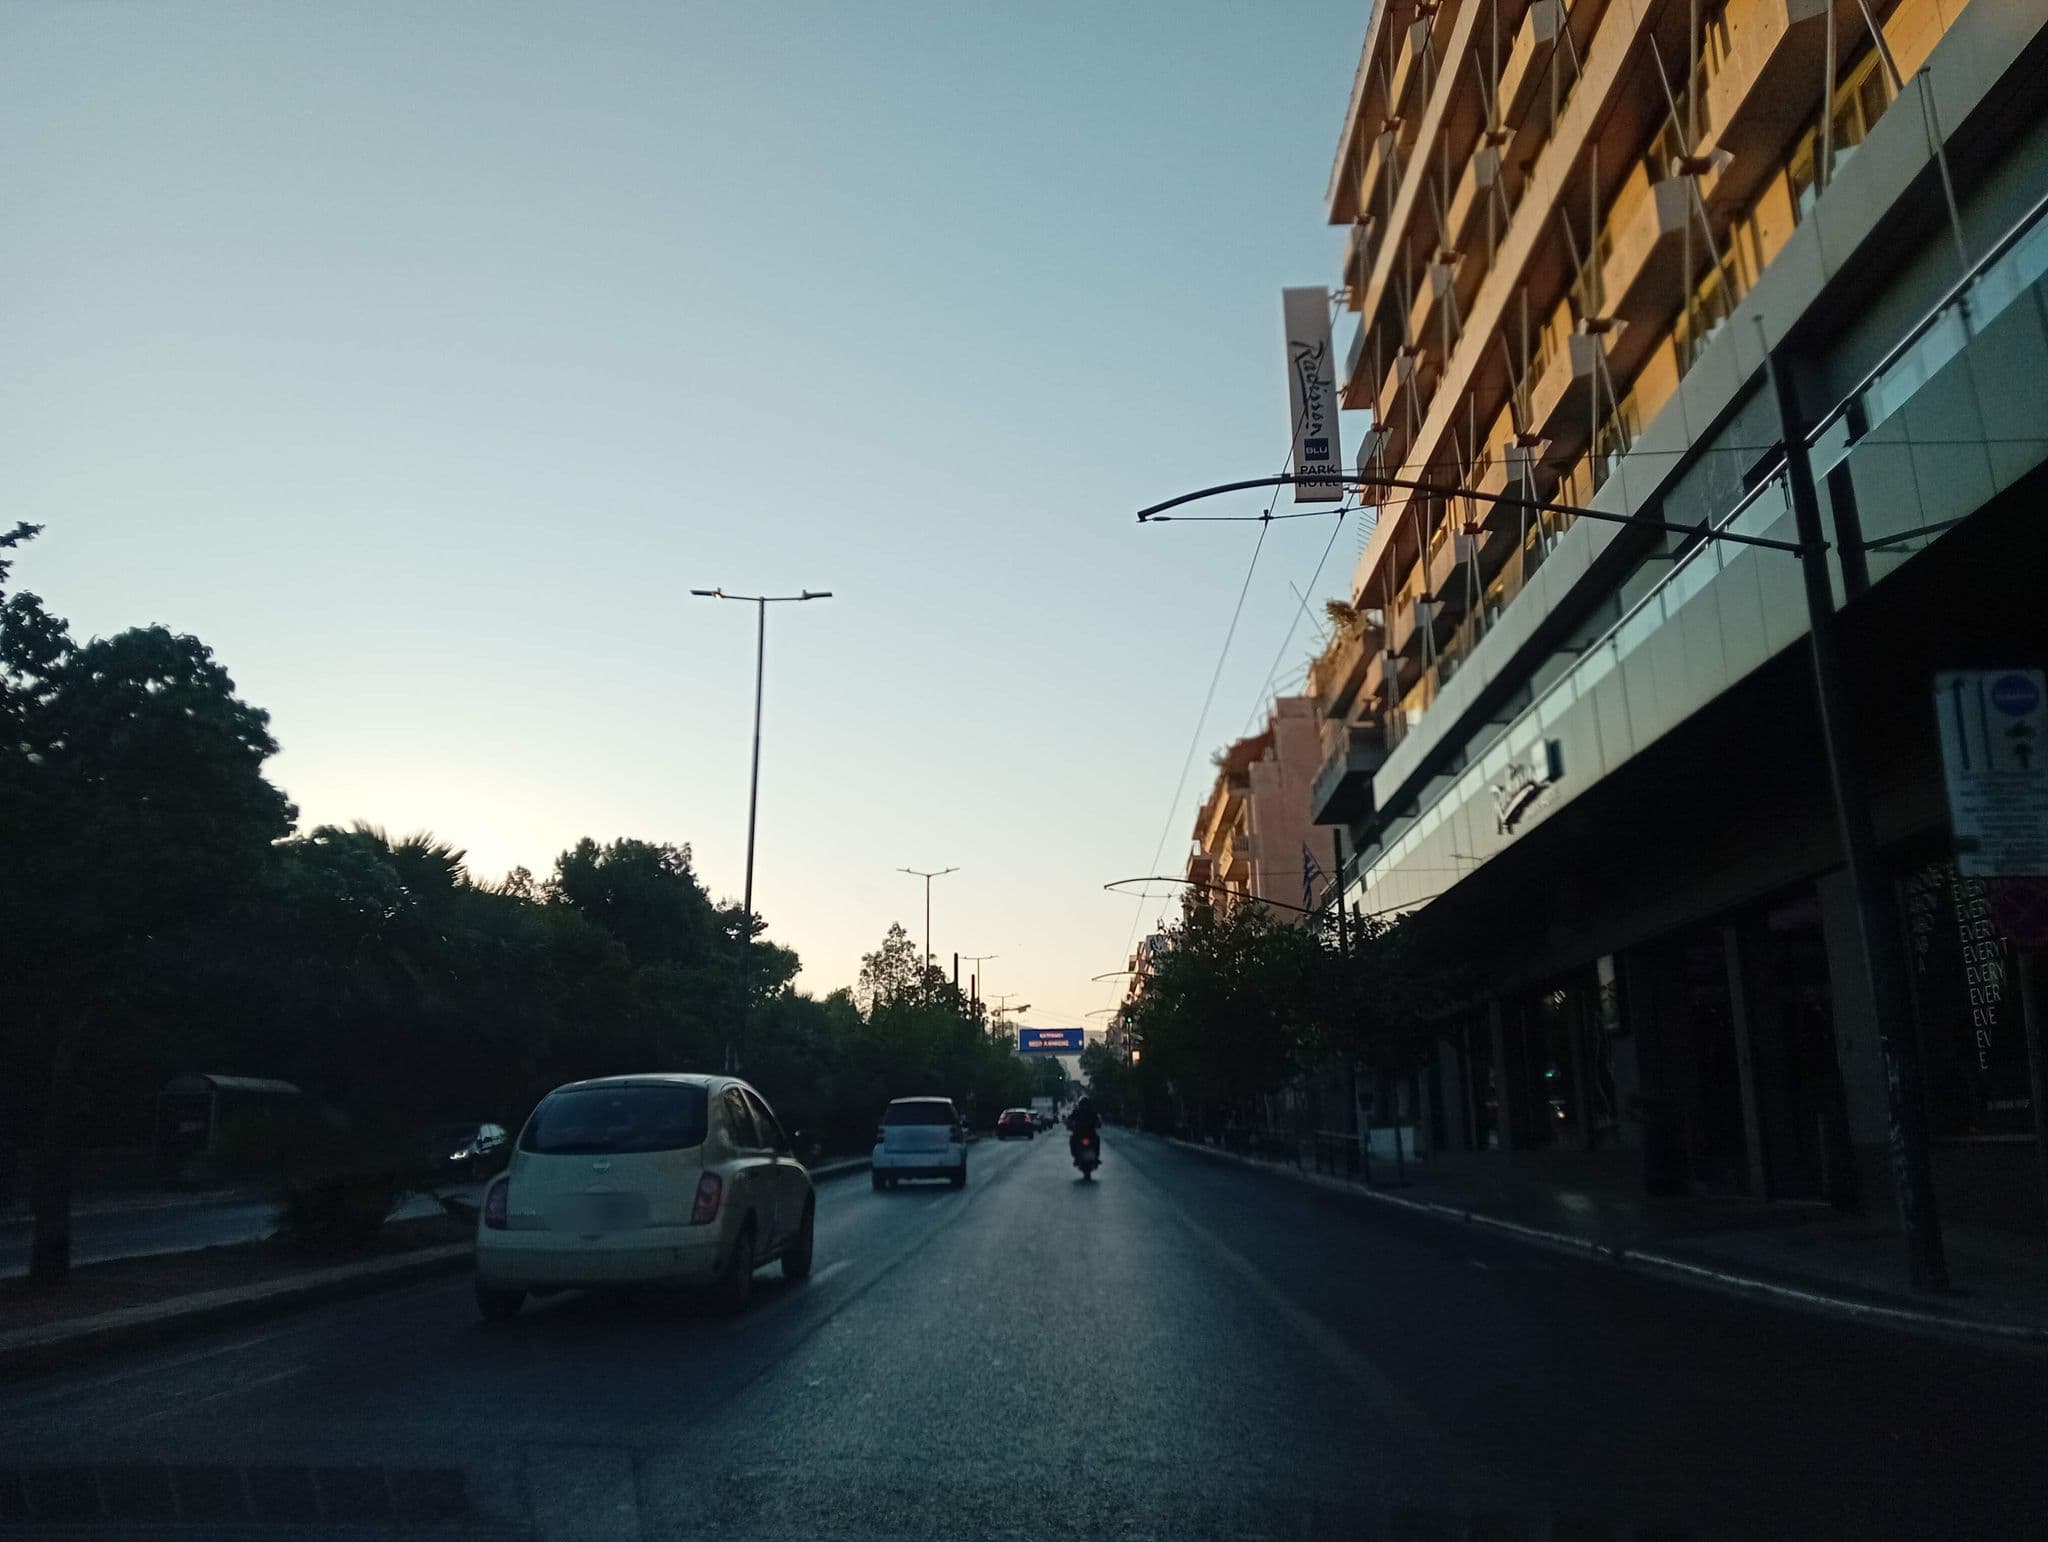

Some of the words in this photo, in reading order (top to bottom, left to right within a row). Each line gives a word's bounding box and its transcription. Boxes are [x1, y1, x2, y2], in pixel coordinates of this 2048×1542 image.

[1305, 446, 1328, 455] BLU
[1300, 464, 1336, 475] PARK
[1970, 984, 2001, 1006] EVER
[1973, 1006, 1997, 1027] EVE
[1976, 1029, 1992, 1048] EV
[1979, 1051, 1989, 1070] E
